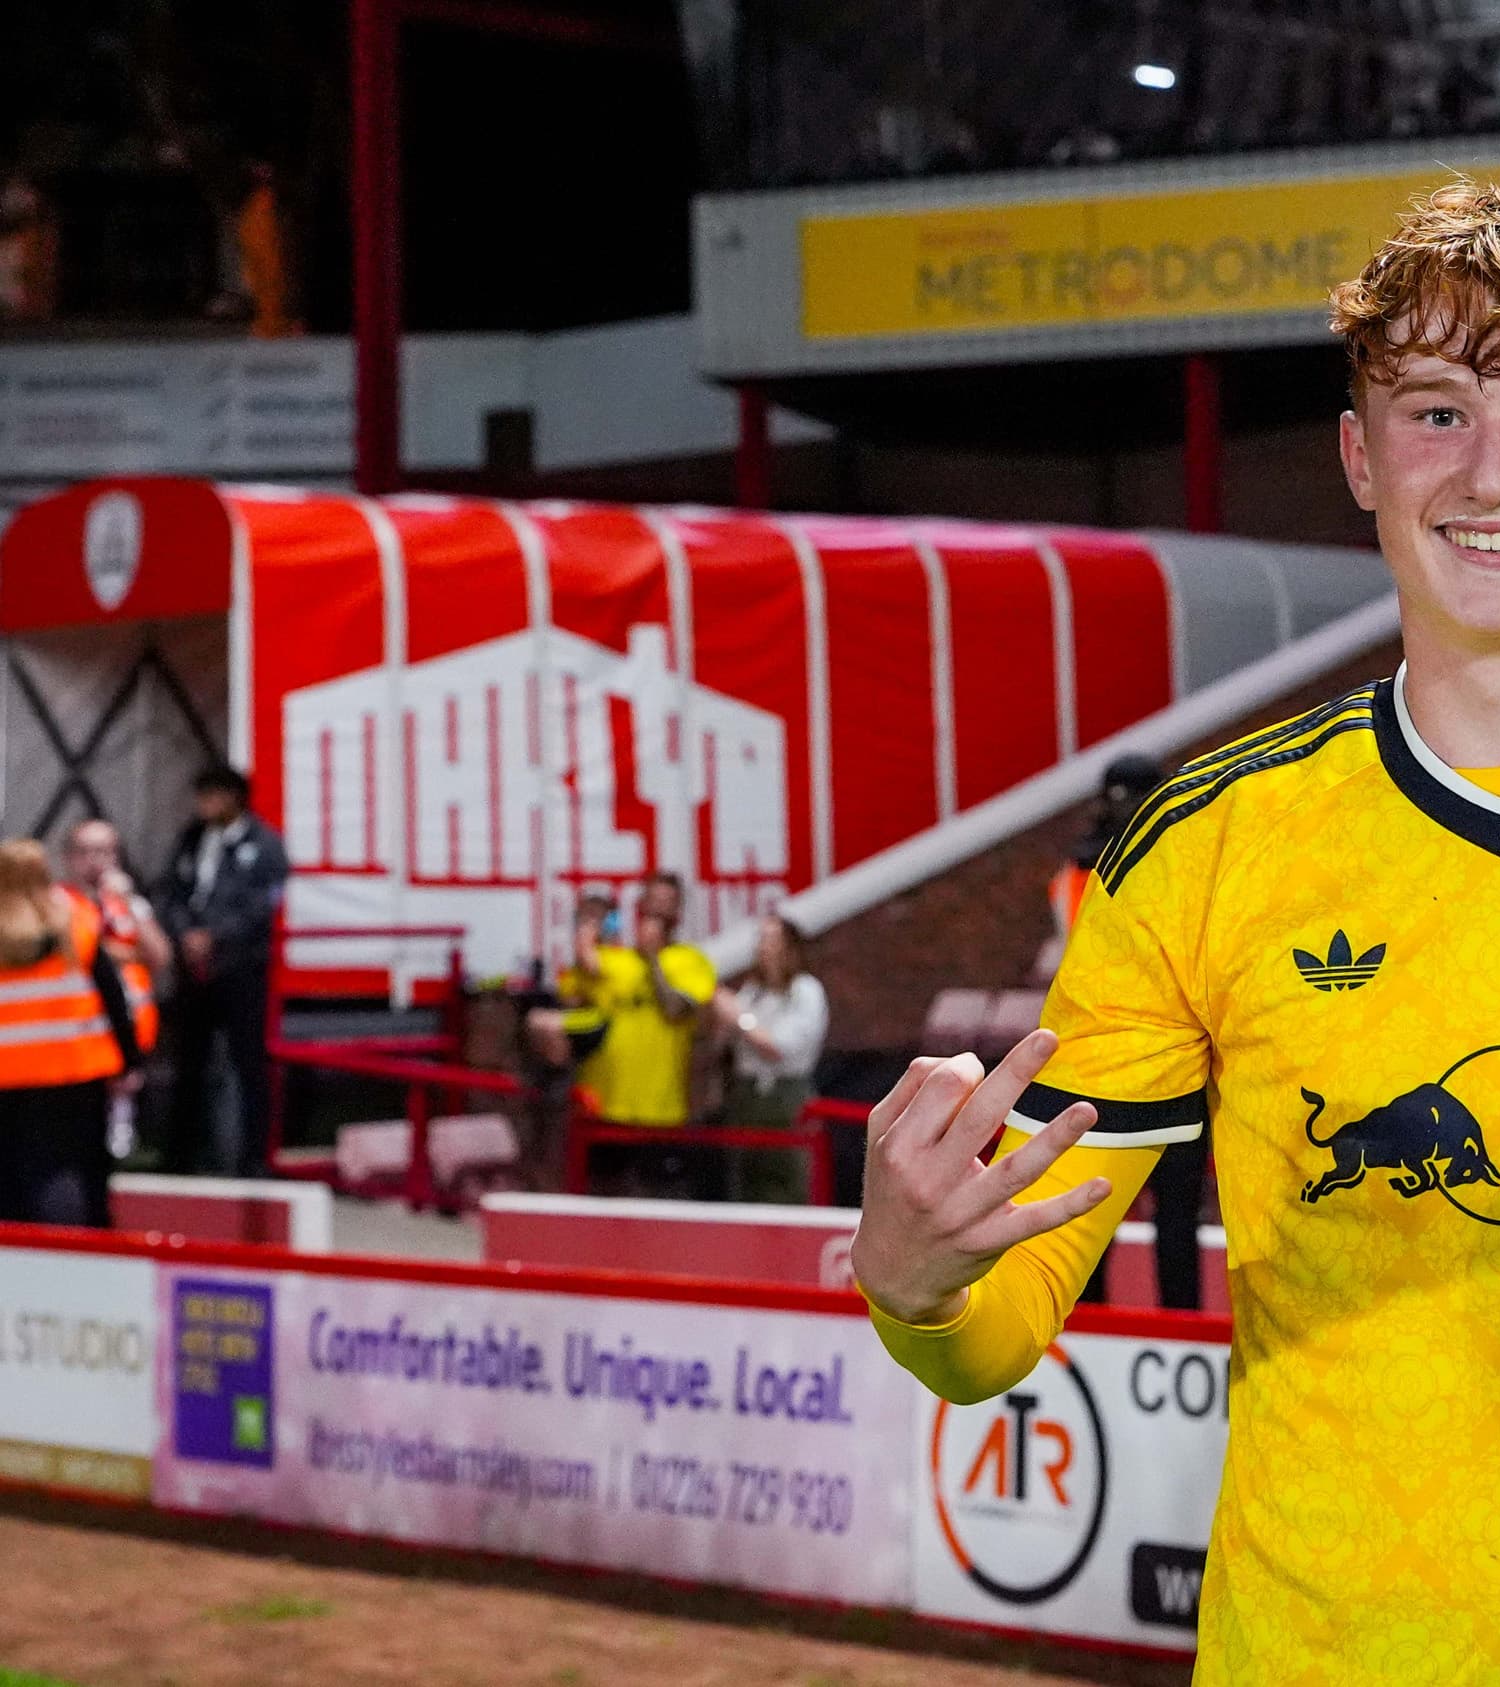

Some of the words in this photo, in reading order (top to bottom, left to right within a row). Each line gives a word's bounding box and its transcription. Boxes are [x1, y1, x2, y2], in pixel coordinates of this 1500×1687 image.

[914, 208, 1350, 316] METRODOME
[14, 1309, 144, 1377] STUDIO
[308, 1308, 552, 1395] Comfortable.
[565, 1331, 720, 1425] Unique.
[963, 1392, 1076, 1506] ATR
